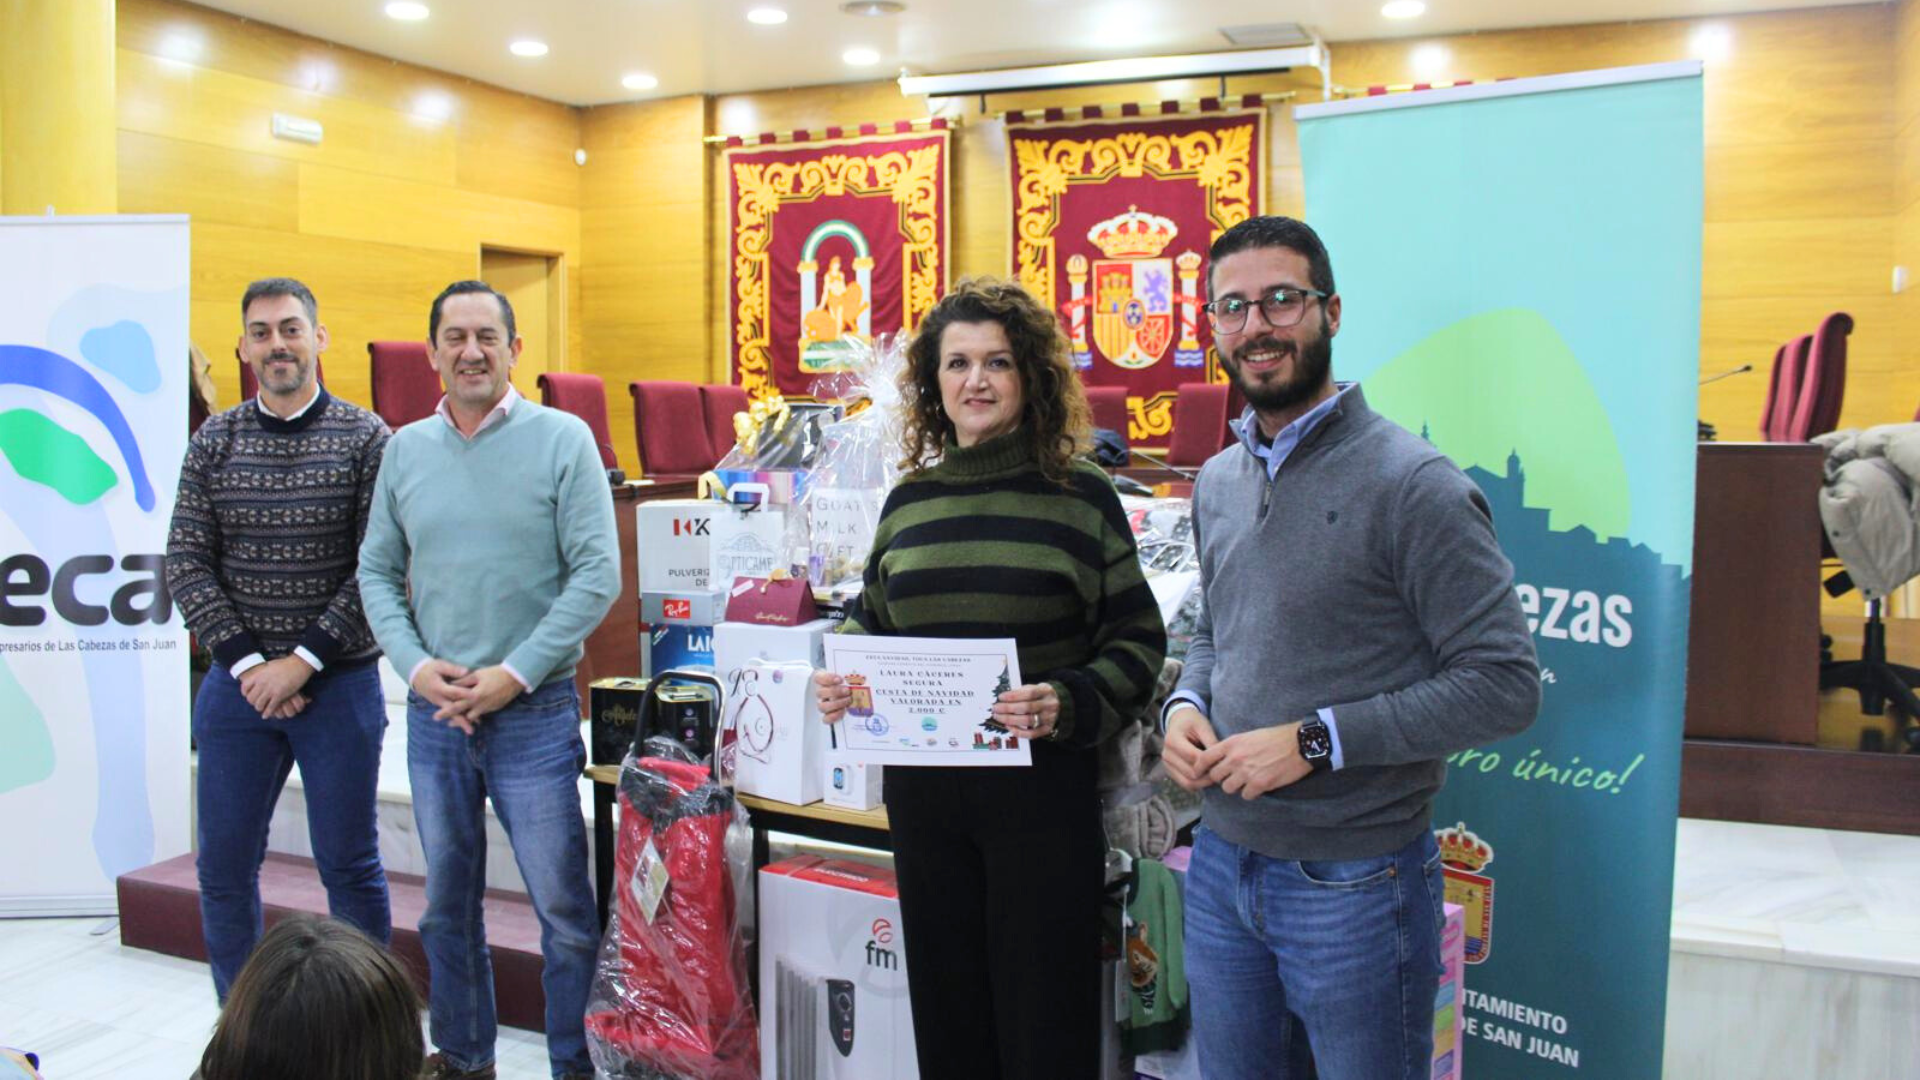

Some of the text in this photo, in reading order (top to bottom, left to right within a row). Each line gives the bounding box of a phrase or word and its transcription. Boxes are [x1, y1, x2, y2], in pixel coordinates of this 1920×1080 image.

[695, 578, 708, 587] DE
[44, 640, 55, 651] de
[58, 640, 75, 651] Las
[78, 639, 117, 651] Cabezas
[119, 638, 130, 650] de
[132, 638, 150, 650] San
[152, 638, 177, 650] Juan
[880, 669, 913, 677] LAURA
[1512, 749, 1645, 794] único!
[865, 940, 898, 971] fm
[1483, 1023, 1522, 1049] SAN
[1526, 1037, 1579, 1068] JUAN
